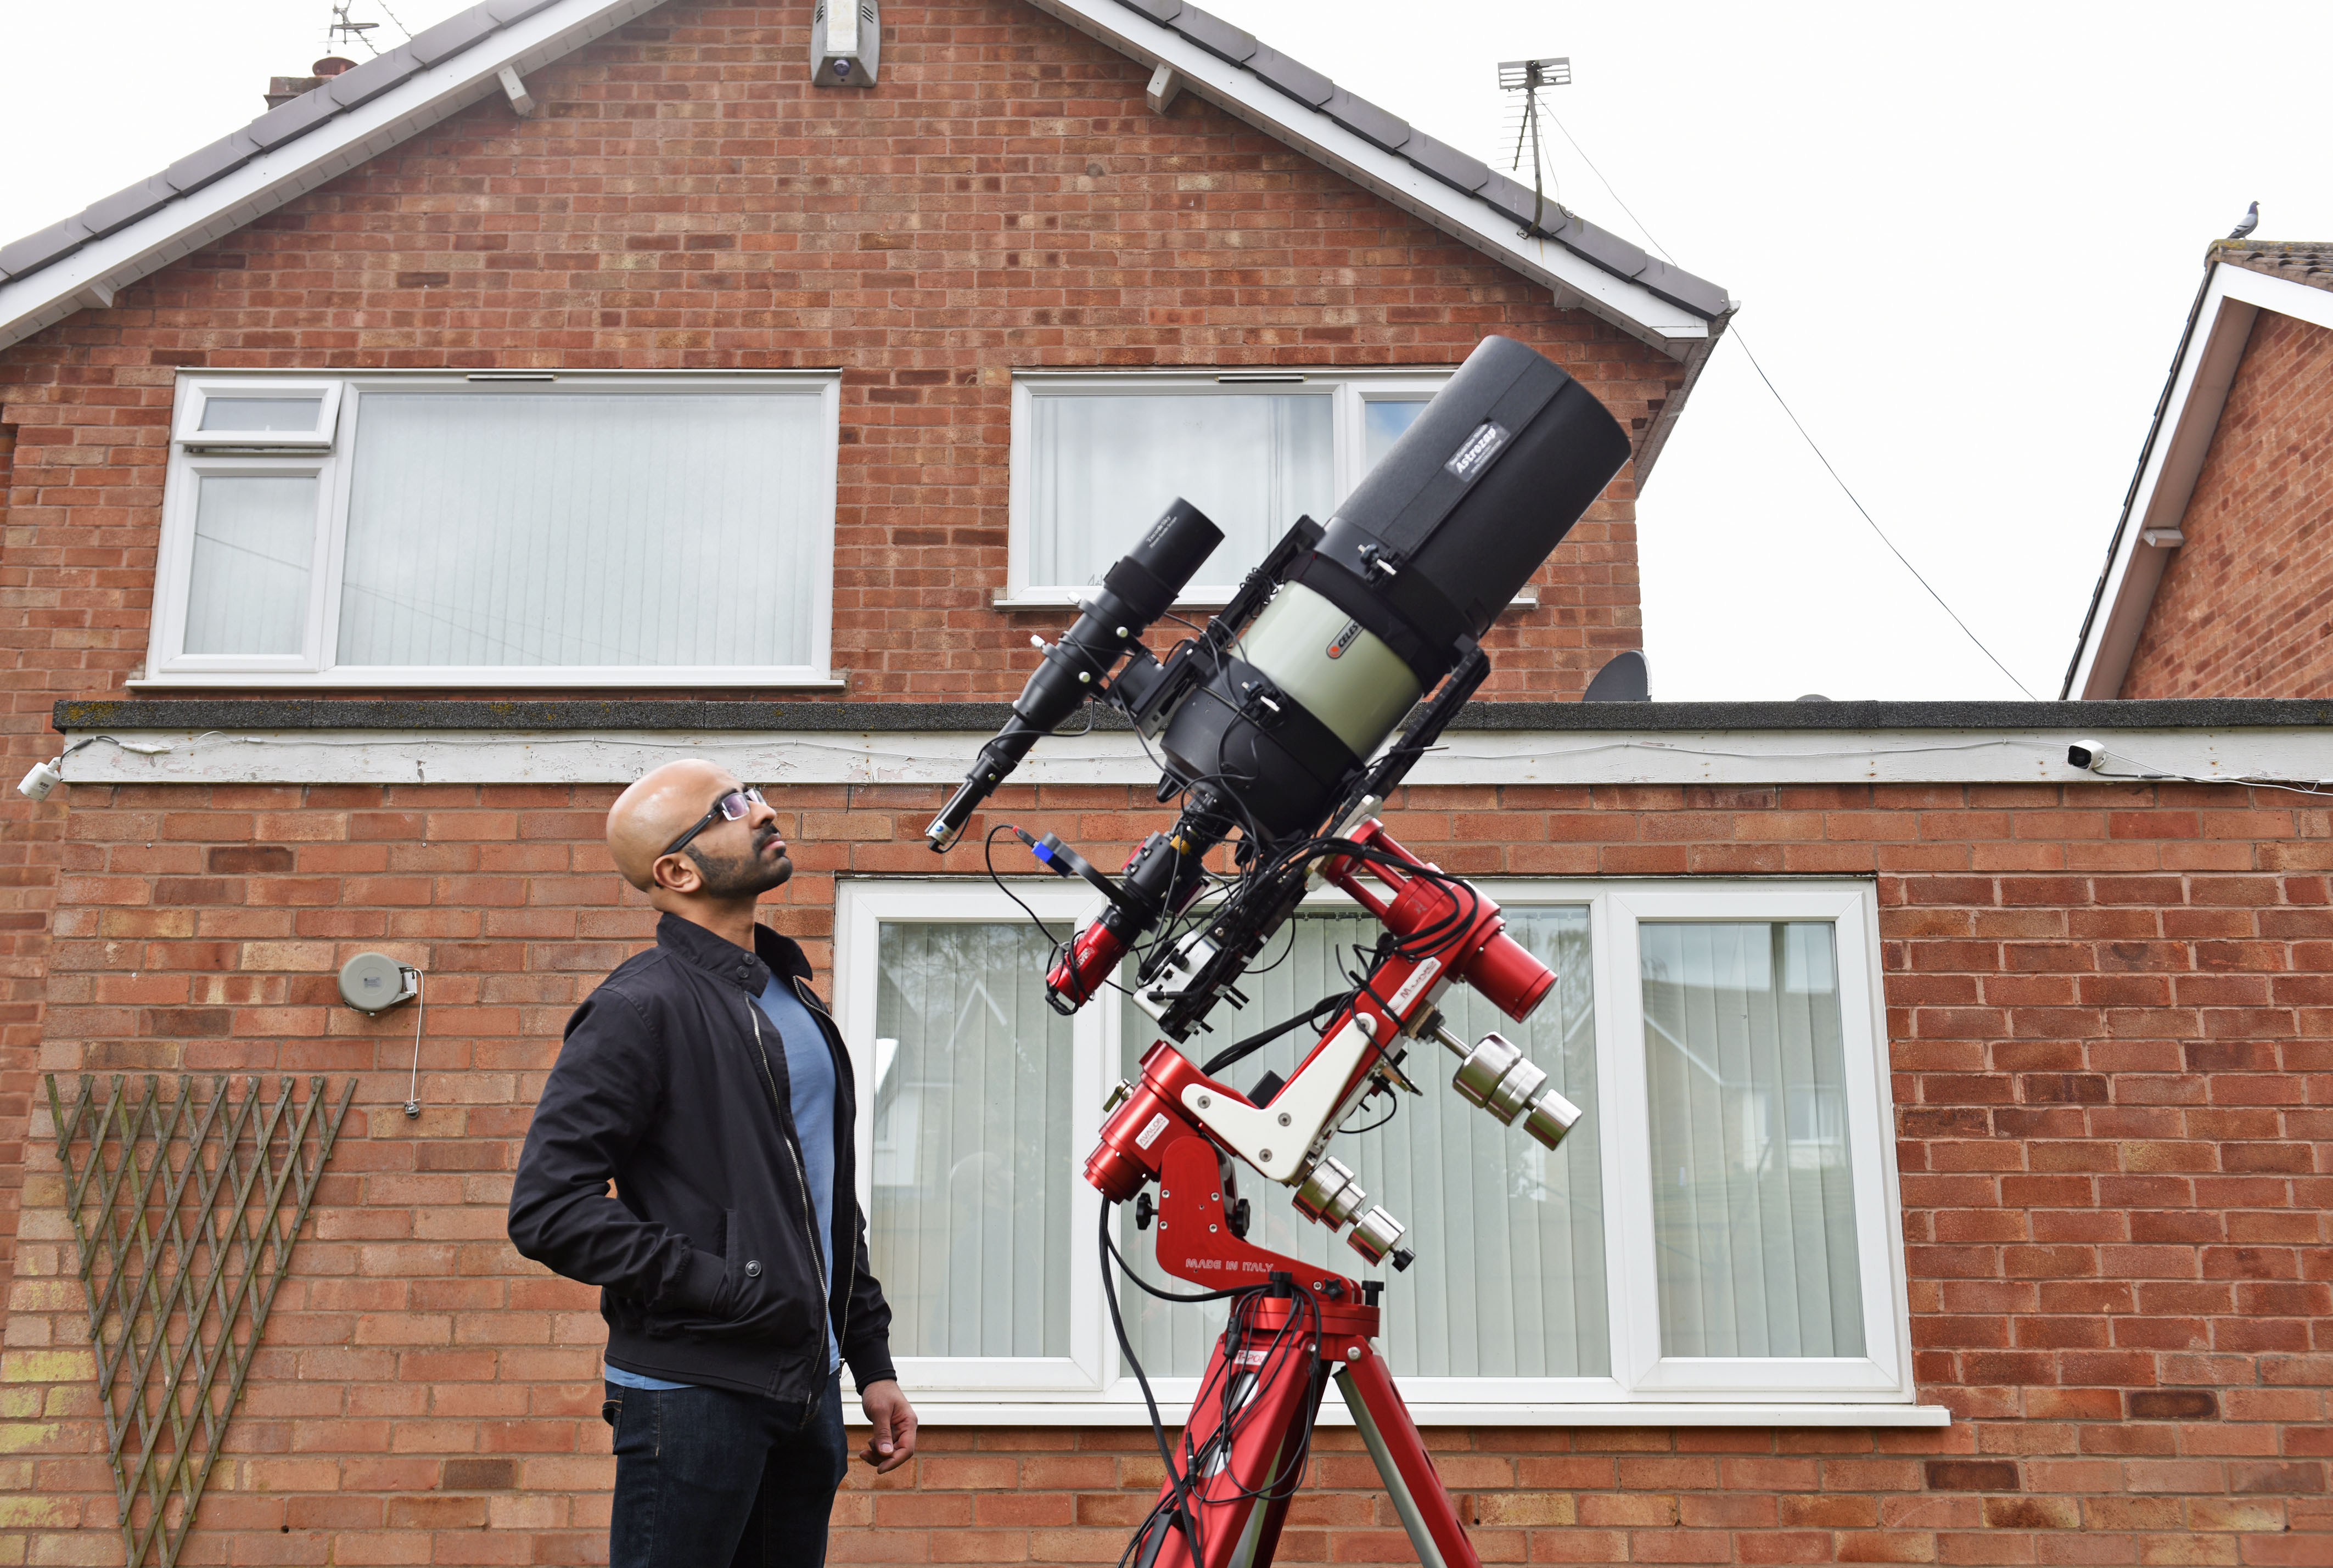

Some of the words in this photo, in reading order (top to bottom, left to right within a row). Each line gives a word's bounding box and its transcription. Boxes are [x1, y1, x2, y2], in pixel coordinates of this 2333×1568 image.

[1456, 428, 1496, 474] Astrozap
[1338, 621, 1358, 647] CELES
[1139, 1116, 1163, 1145] AVALON
[1186, 1258, 1221, 1269] MADE
[1226, 1261, 1238, 1270] IN
[1242, 1261, 1274, 1272] ITALY
